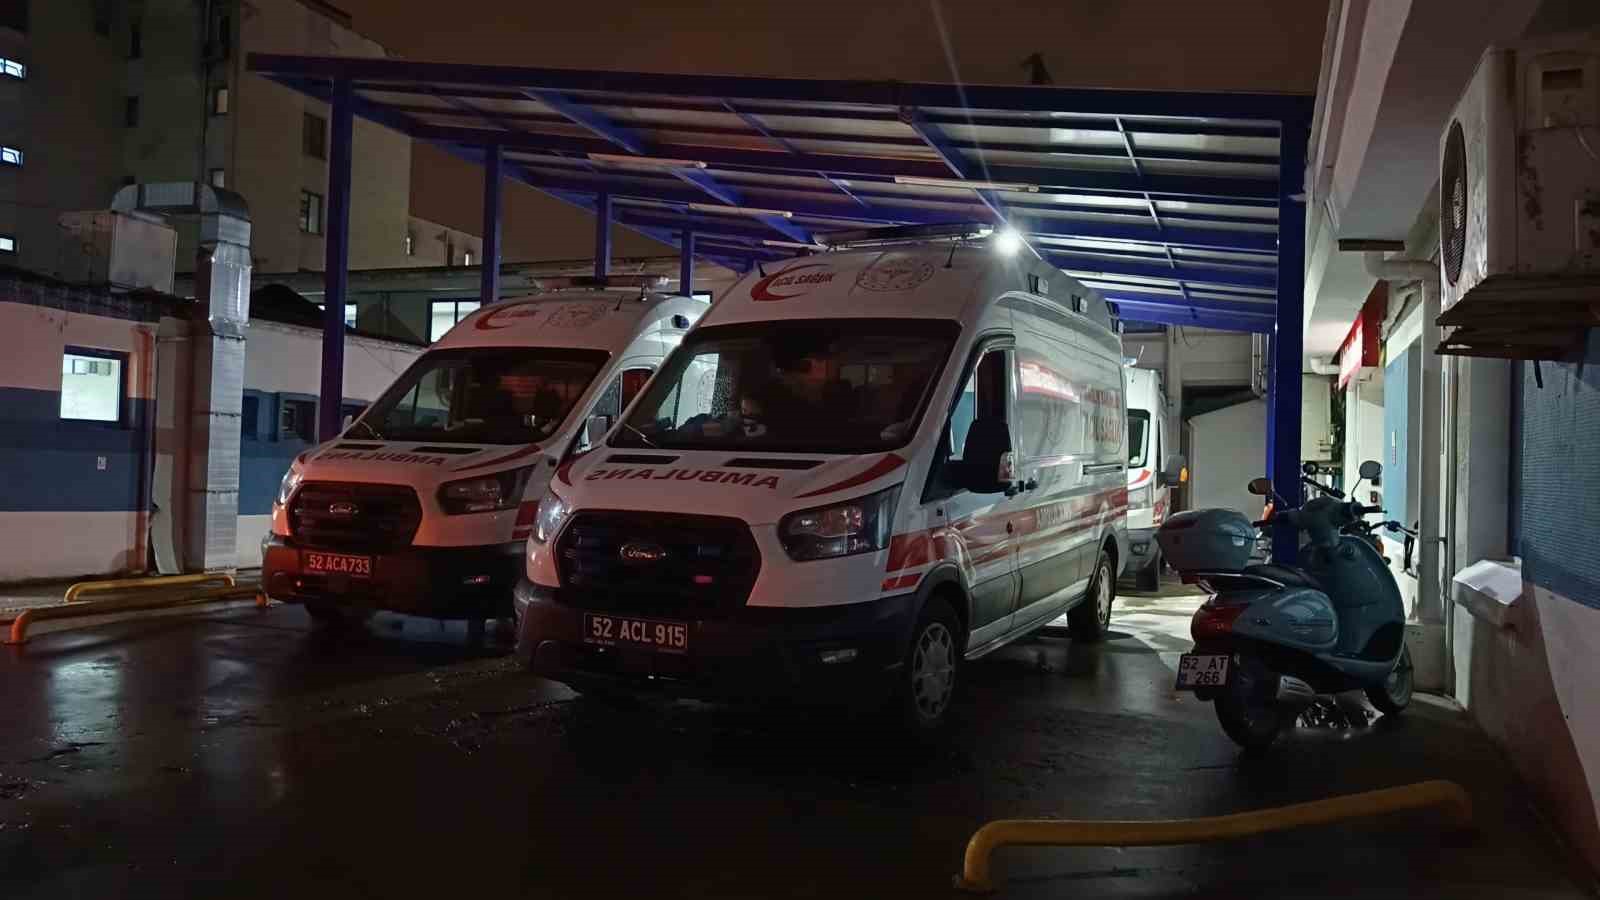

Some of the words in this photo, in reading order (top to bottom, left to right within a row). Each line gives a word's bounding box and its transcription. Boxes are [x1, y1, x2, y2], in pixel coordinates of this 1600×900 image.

[309, 554, 323, 569] 52
[592, 617, 613, 638] 52
[619, 620, 652, 643] ACL
[655, 624, 685, 647] 915
[1183, 657, 1199, 670] 52
[1208, 657, 1227, 670] AT
